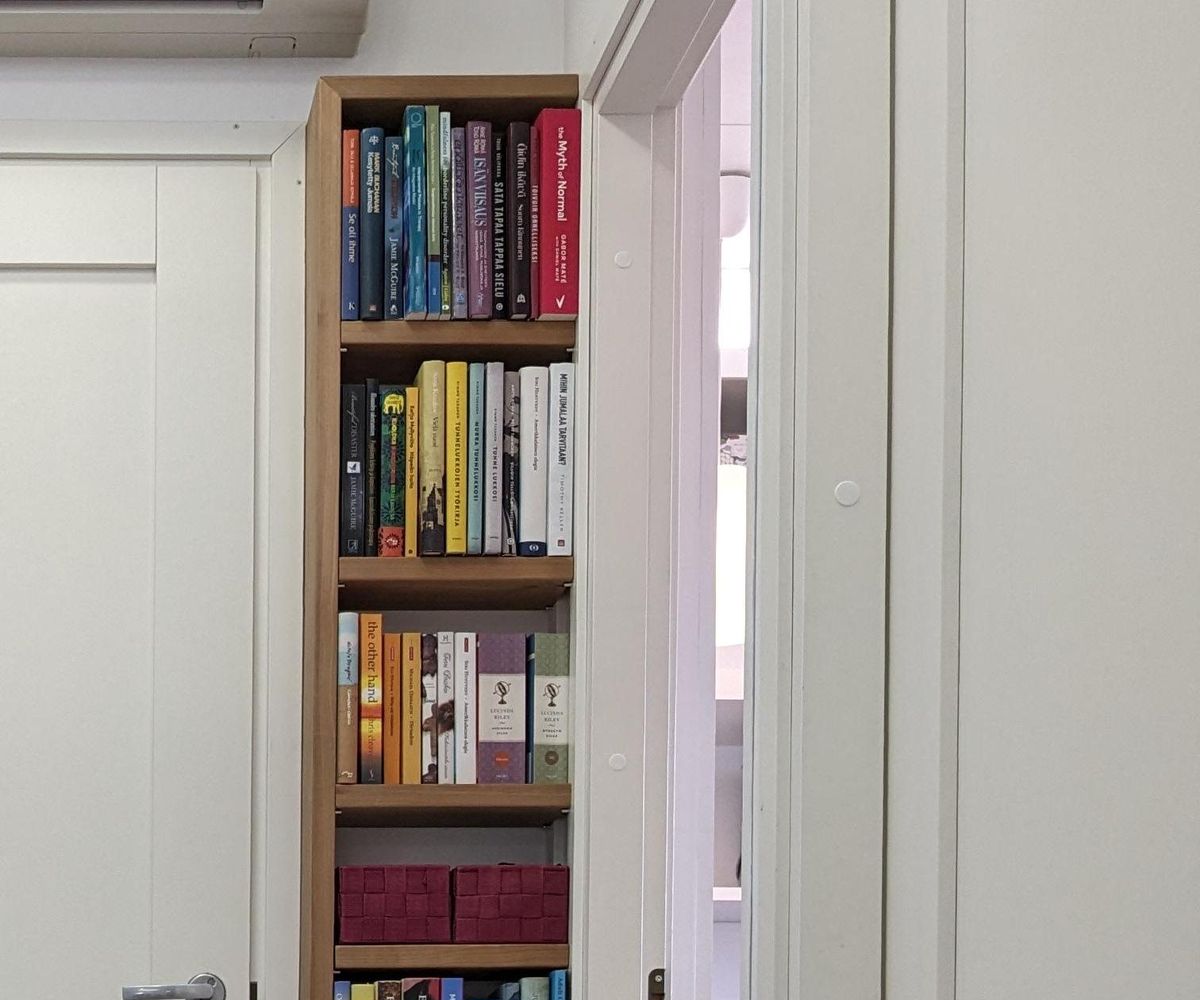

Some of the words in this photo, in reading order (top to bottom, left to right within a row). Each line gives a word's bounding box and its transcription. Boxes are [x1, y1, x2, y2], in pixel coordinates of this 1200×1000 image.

[556, 140, 568, 170] Myth
[474, 157, 489, 183] ISÄN
[558, 171, 565, 179] of
[441, 168, 449, 200] borderline
[494, 182, 504, 206] SATA
[474, 184, 488, 227] VIISAUS
[557, 181, 567, 221] Normal
[349, 214, 357, 224] Se
[349, 226, 357, 239] oli
[440, 202, 449, 237] personality
[494, 207, 504, 234] TAPAA
[348, 240, 357, 263] ihme
[390, 237, 398, 260] JAMIE
[441, 238, 449, 264] disorder
[494, 237, 504, 270] TAPPAA
[494, 272, 504, 297] SIELU
[558, 374, 567, 393] MIHIN
[558, 394, 567, 426] JUMALAA
[558, 428, 566, 466] TARVITAAN?
[454, 490, 462, 527] TYÖKIRJA
[368, 622, 378, 639] the
[368, 642, 378, 672] other
[367, 675, 378, 703] hand
